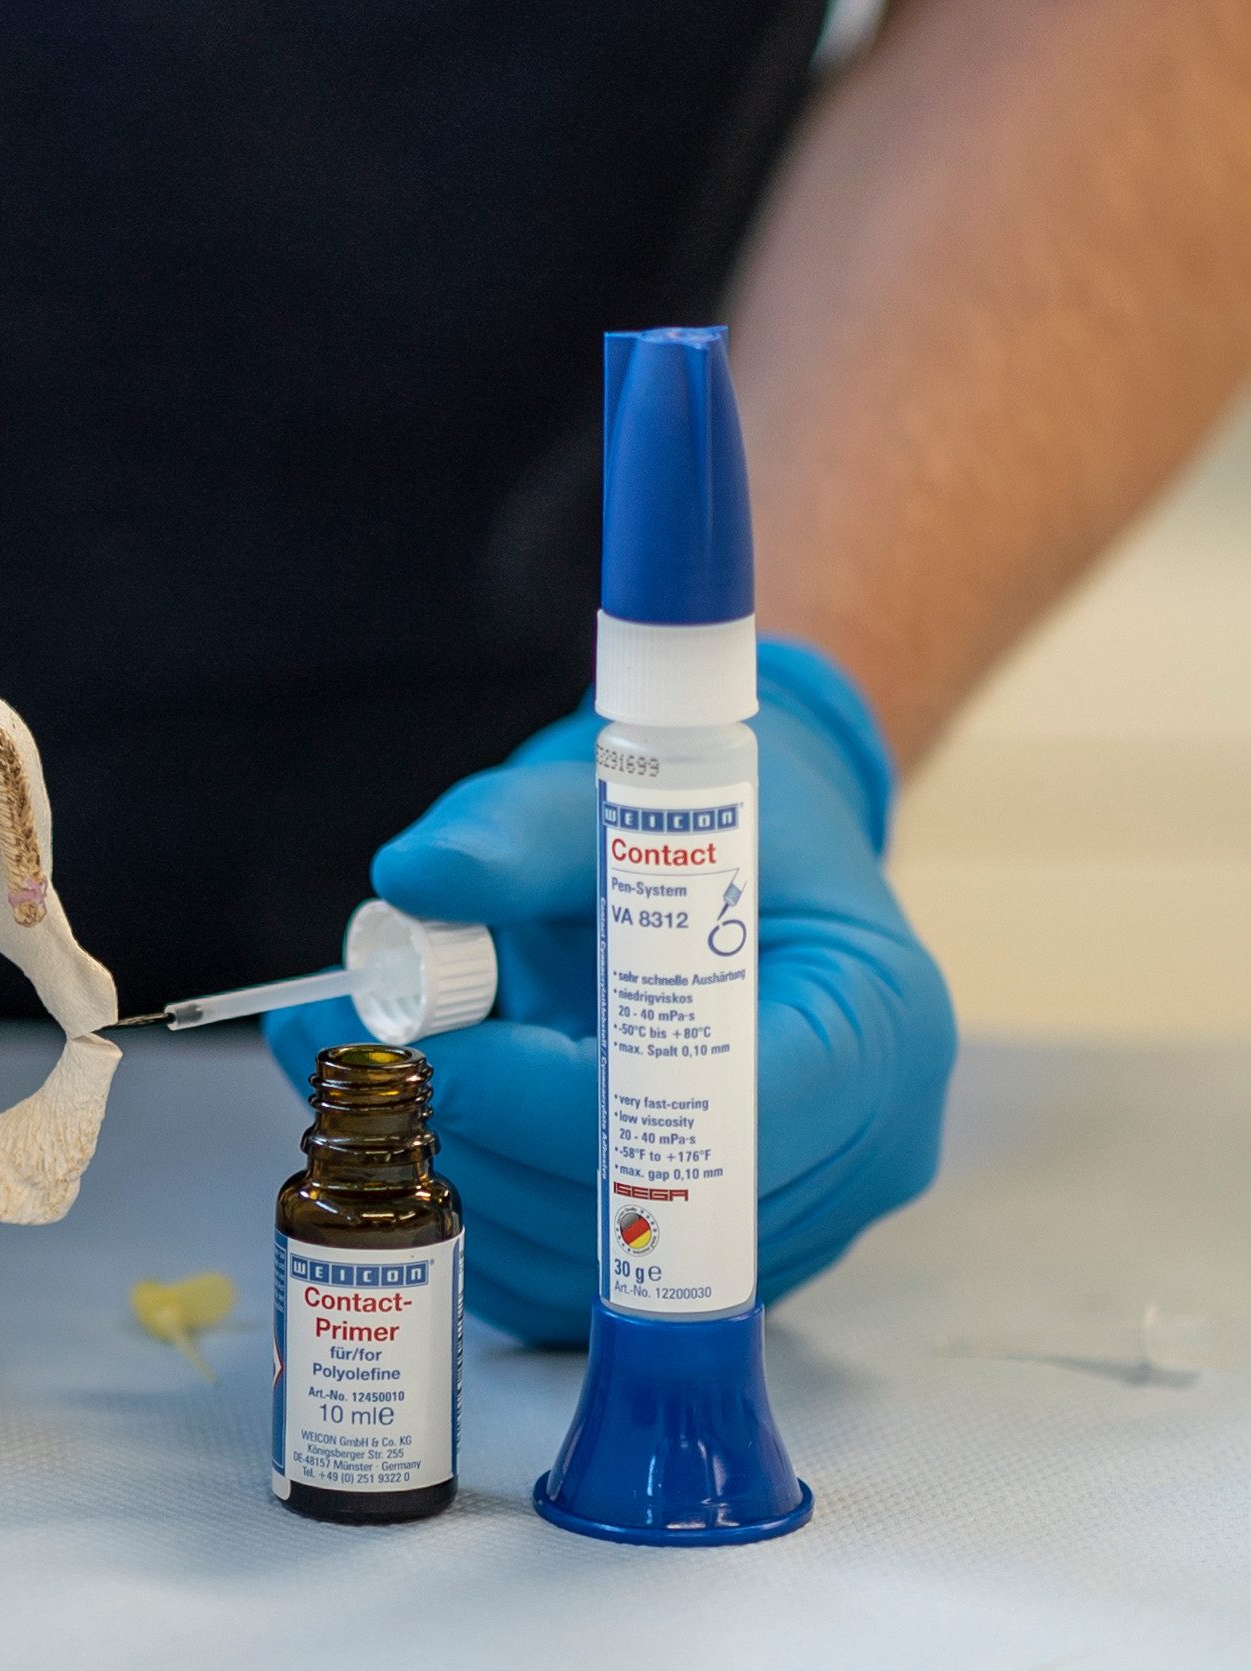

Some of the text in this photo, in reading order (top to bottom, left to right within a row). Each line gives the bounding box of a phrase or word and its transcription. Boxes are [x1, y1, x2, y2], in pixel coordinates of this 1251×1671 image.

[612, 838, 716, 866] Contact
[612, 877, 687, 898] Pen-System
[612, 905, 689, 929] VA 8312
[618, 969, 746, 986] sehr schnelle Aushärtung
[618, 988, 693, 1006] niedrigviskos
[618, 1005, 630, 1018] 20
[641, 1008, 654, 1021] 40
[618, 1023, 646, 1037] -50°C
[650, 1026, 667, 1039] bis
[618, 1042, 730, 1058] max. Spalt 0,10 mm
[619, 1095, 709, 1111] very fast-curing
[619, 1111, 695, 1129] low viscosity
[619, 1128, 631, 1140] 20
[641, 1132, 655, 1144] 40
[619, 1146, 645, 1160] -58°F
[649, 1150, 661, 1162] to
[619, 1165, 644, 1178] max.
[648, 1168, 670, 1182] gap
[703, 1167, 723, 1178] mm
[613, 1181, 689, 1202] ISEGA
[293, 1258, 423, 1284] WEICON
[614, 1258, 630, 1277] 30
[304, 1286, 412, 1313] Contact-
[614, 1281, 712, 1300] Art.-No. 12200030
[316, 1317, 400, 1342] Primer
[330, 1346, 382, 1361] für/for
[313, 1363, 401, 1382] Polyolefine
[308, 1386, 405, 1403] Art.-No. 12450010
[320, 1404, 344, 1423] 10
[301, 1430, 412, 1447] WEICON GmbH & Co. KG
[293, 1451, 421, 1471] DE-48157 Münster Germany
[307, 1444, 404, 1461] Königsberger Str. 255
[303, 1466, 315, 1478] Tel.
[341, 1473, 354, 1484] (0)
[357, 1473, 374, 1483] 251
[378, 1472, 401, 1483] 9322
